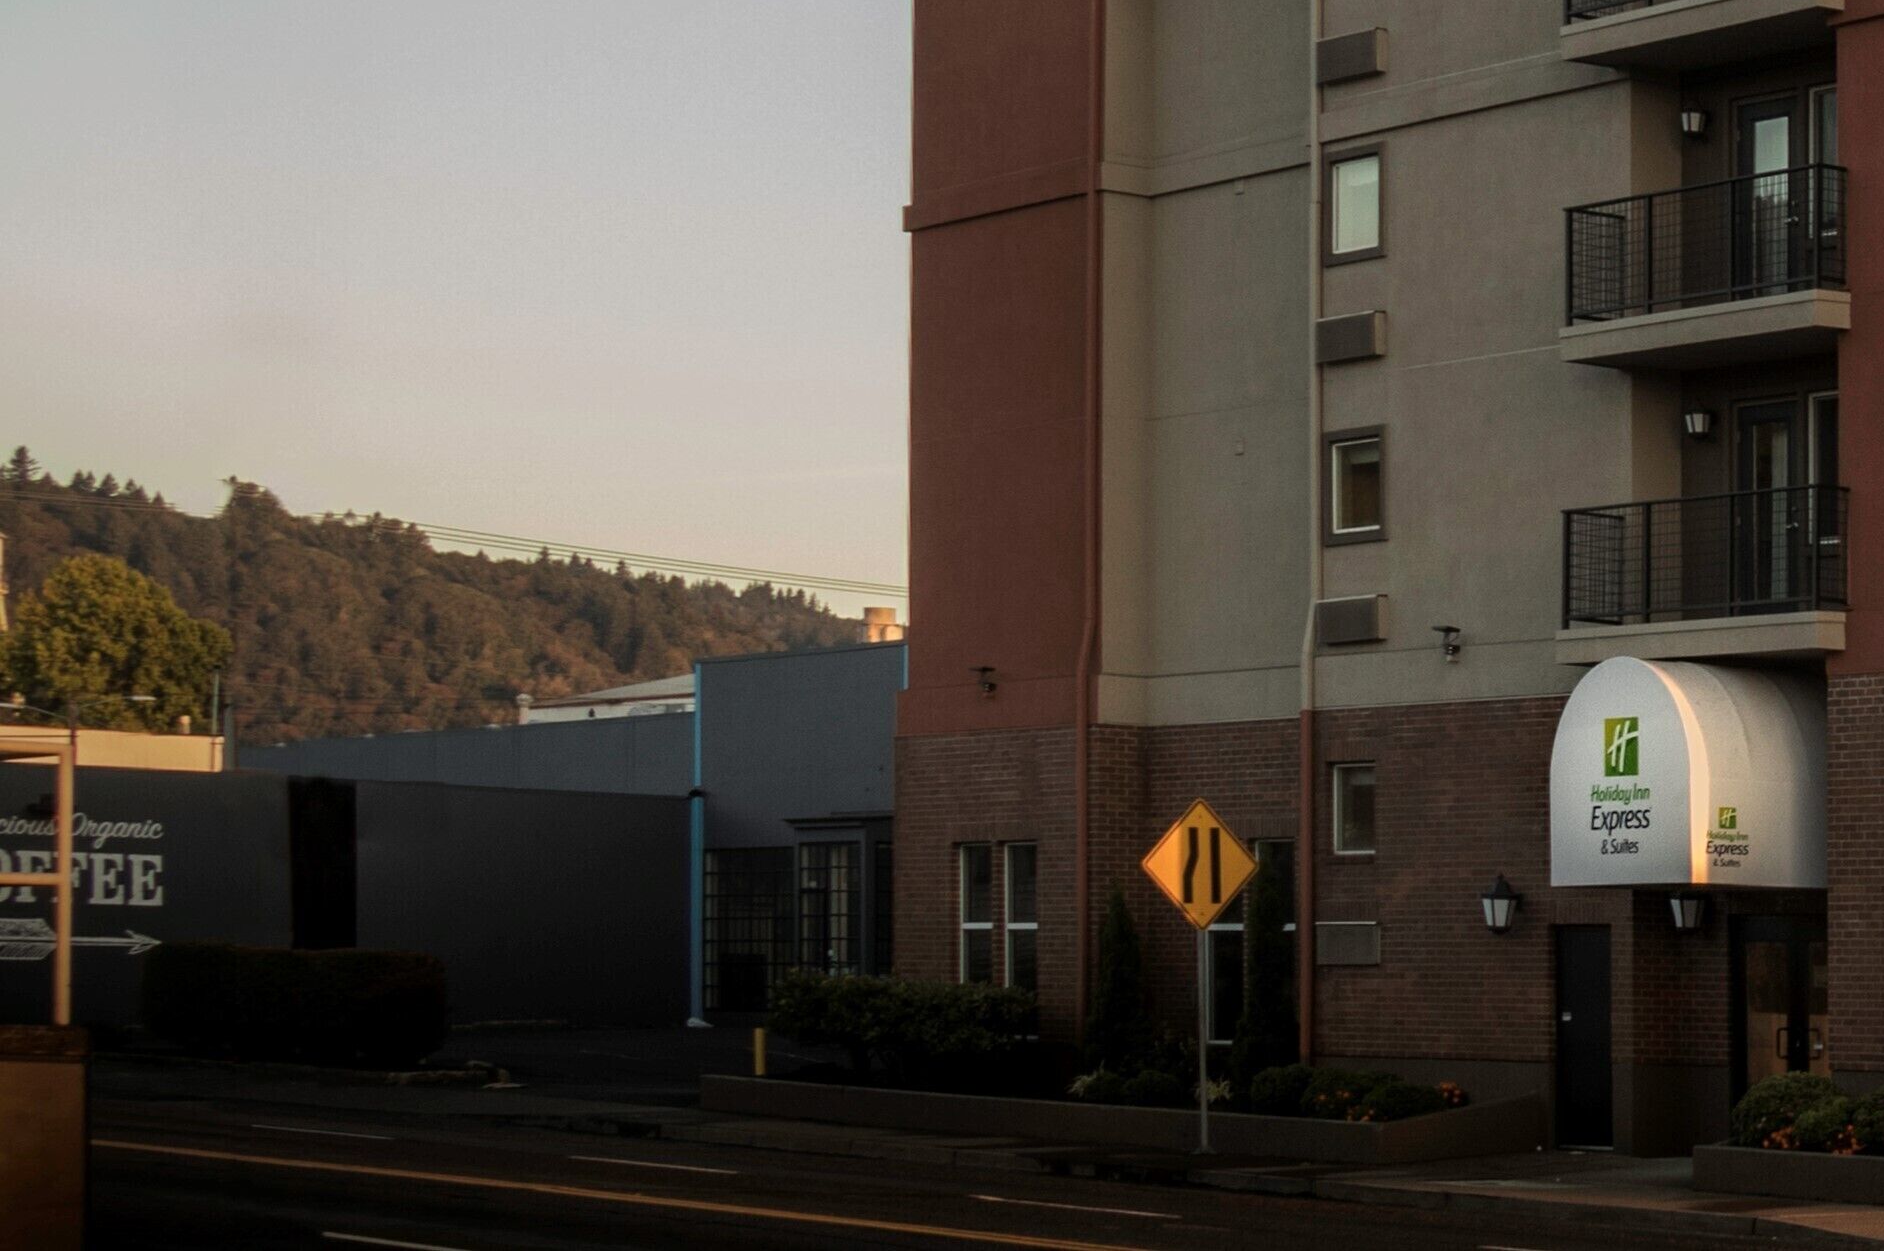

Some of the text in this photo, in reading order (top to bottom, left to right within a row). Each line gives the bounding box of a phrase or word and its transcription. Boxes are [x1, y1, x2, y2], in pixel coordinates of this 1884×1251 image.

[1591, 783, 1650, 805] Holiday Inn
[1591, 805, 1650, 836] Express
[1600, 838, 1639, 855] & Suites
[1706, 840, 1749, 858] Express
